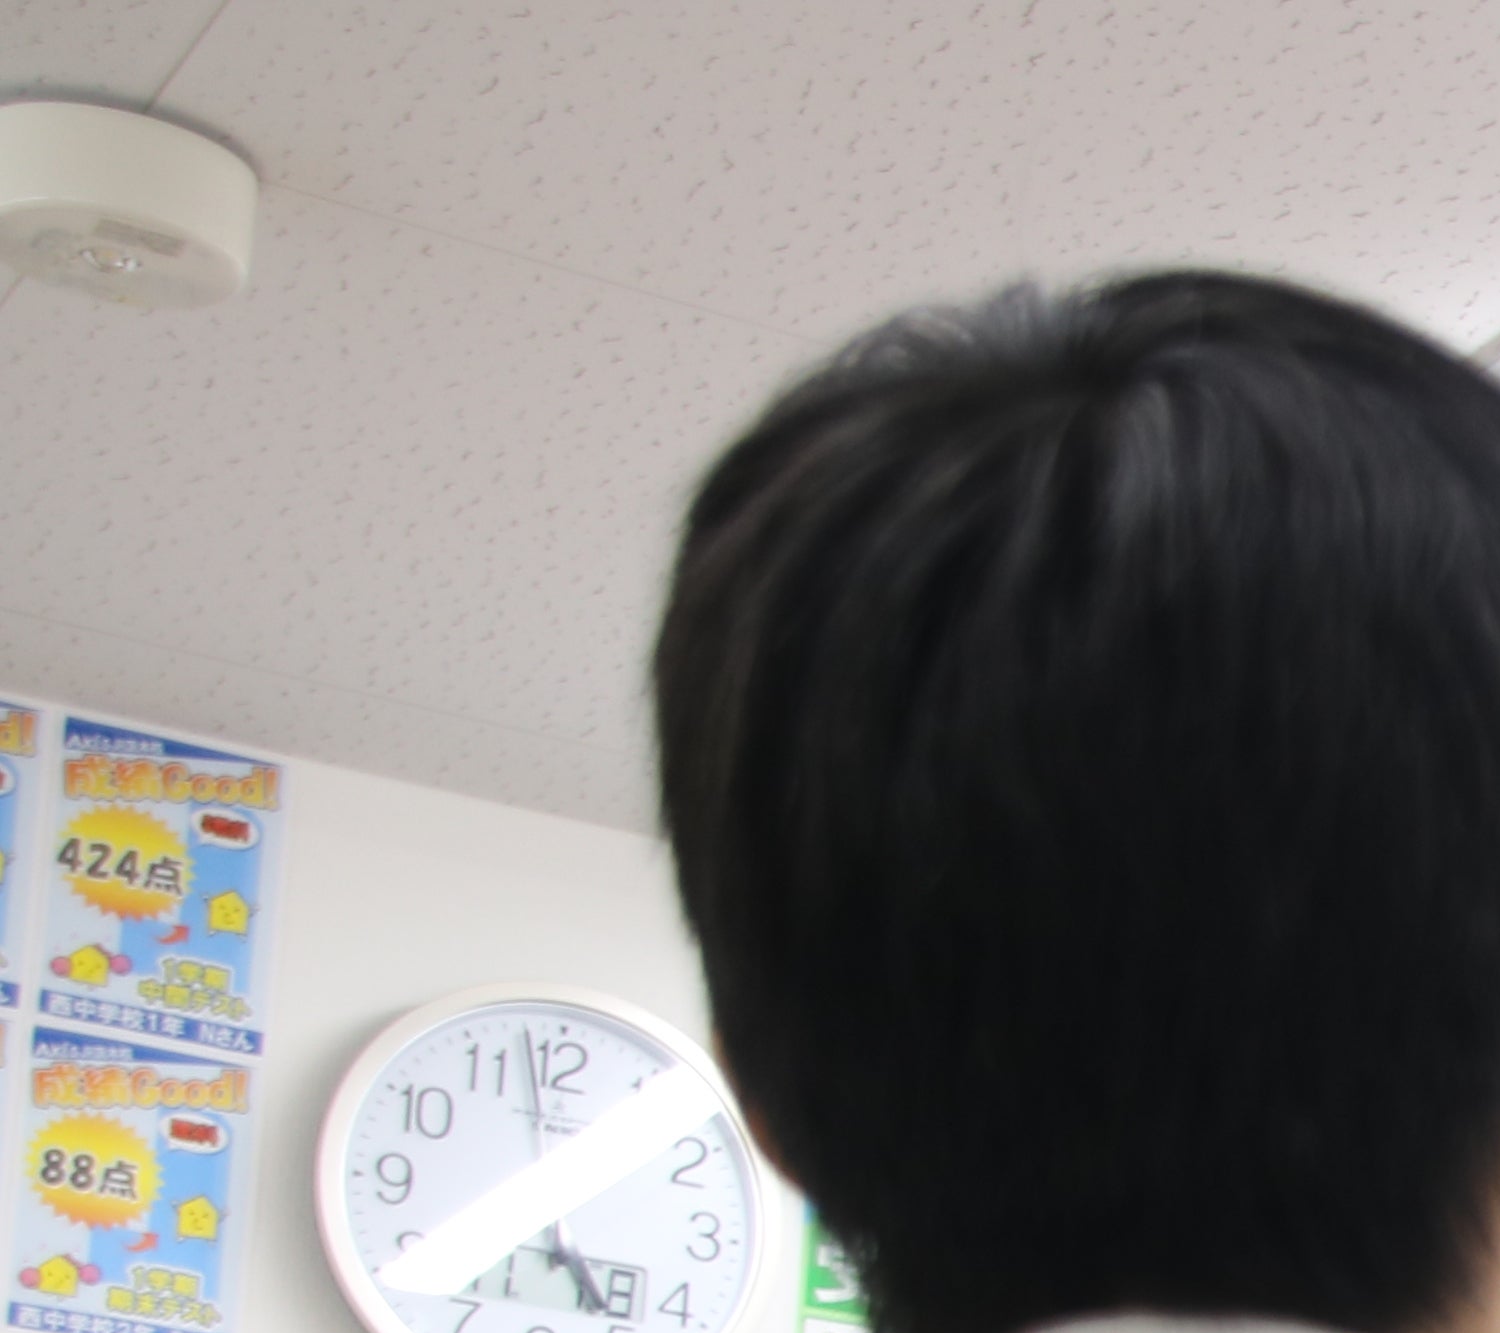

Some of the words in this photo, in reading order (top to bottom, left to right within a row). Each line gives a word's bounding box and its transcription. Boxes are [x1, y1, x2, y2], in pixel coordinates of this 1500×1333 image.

[57, 838, 184, 894] 424点
[466, 1042, 506, 1097] 11
[536, 1040, 588, 1095] 12
[402, 1084, 454, 1140] 10
[40, 1148, 137, 1200] 88点
[376, 1153, 413, 1205] 9
[671, 1136, 708, 1189] 2
[686, 1212, 721, 1262] 3
[658, 1282, 694, 1328] 4
